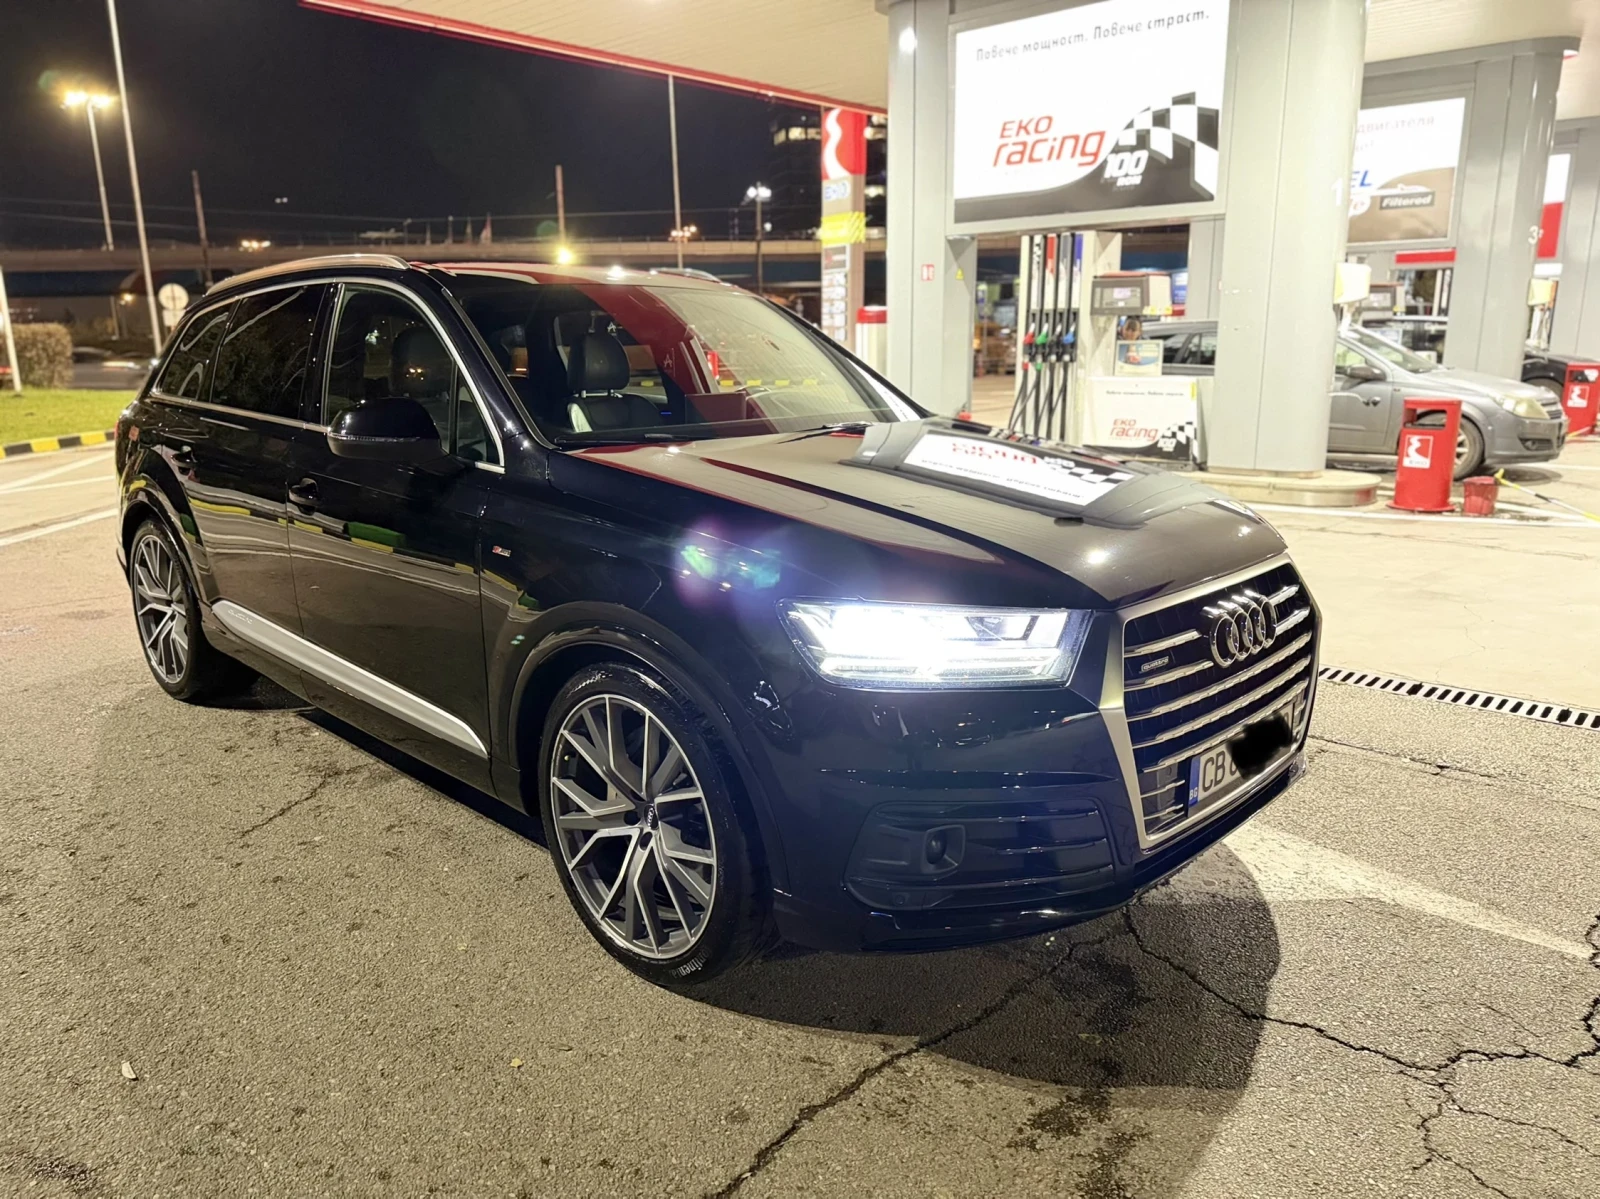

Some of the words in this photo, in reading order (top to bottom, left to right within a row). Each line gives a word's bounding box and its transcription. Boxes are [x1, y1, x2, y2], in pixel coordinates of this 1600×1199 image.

[976, 44, 1018, 61] Повече
[1022, 33, 1088, 53] мощност.
[1093, 21, 1142, 40] Повече
[1147, 9, 1210, 30] страст.
[999, 115, 1053, 139] EKO
[993, 131, 1106, 167] racing
[1103, 149, 1149, 178] 100
[1381, 194, 1432, 208] Filtered
[1113, 418, 1137, 427] EKO
[1110, 427, 1159, 442] racing
[1189, 787, 1198, 800] BG
